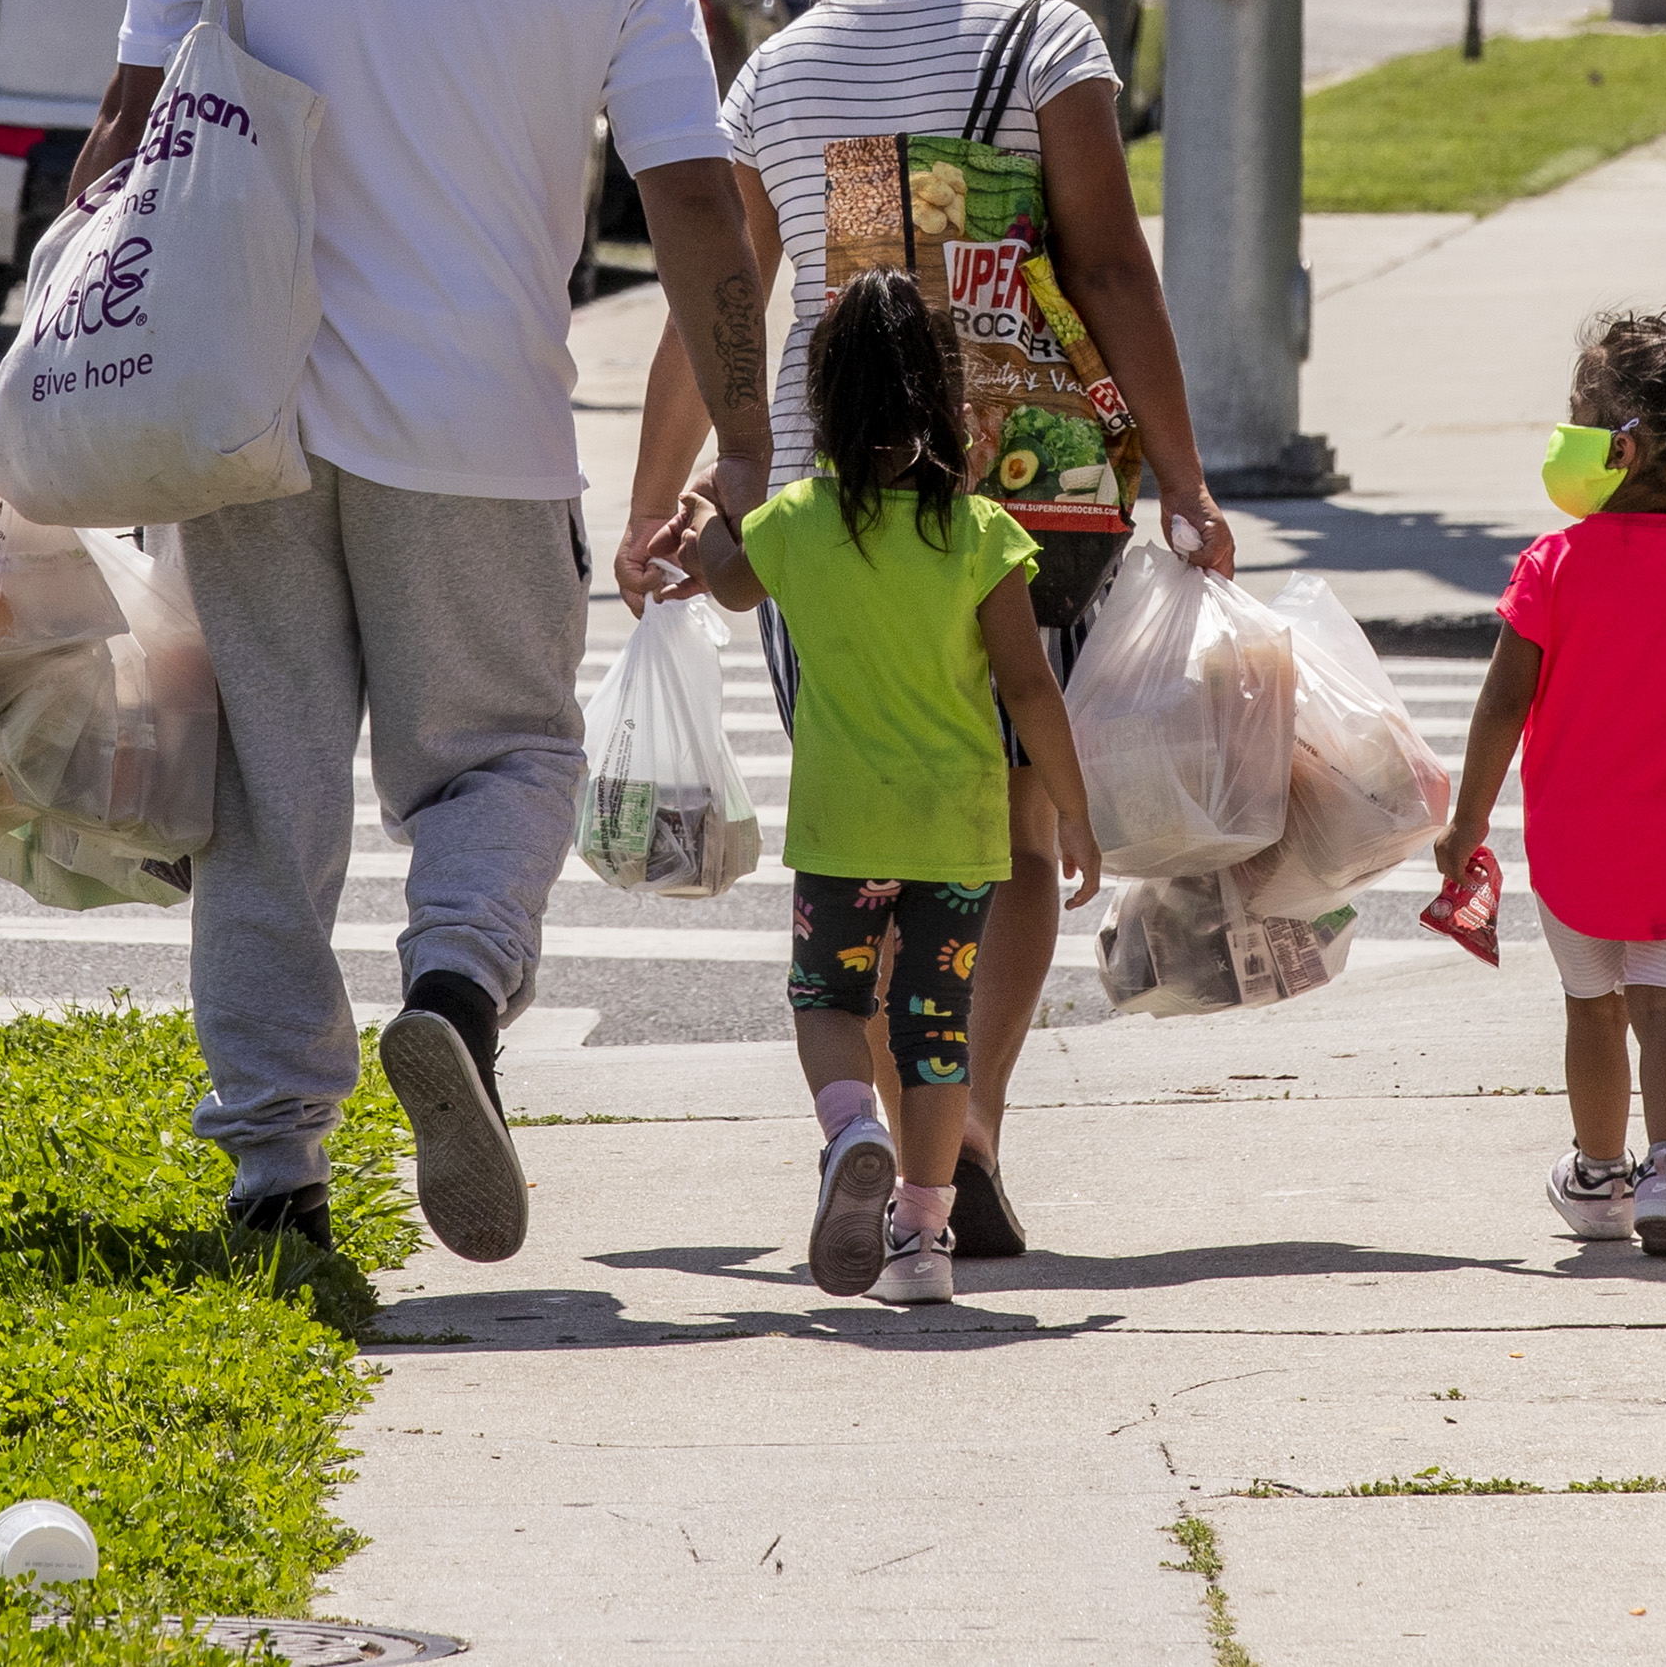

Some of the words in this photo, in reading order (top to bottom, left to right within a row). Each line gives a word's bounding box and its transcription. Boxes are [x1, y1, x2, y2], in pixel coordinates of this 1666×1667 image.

[949, 305, 1071, 363] ROCERS
[32, 367, 77, 402] give
[85, 353, 154, 390] hope
